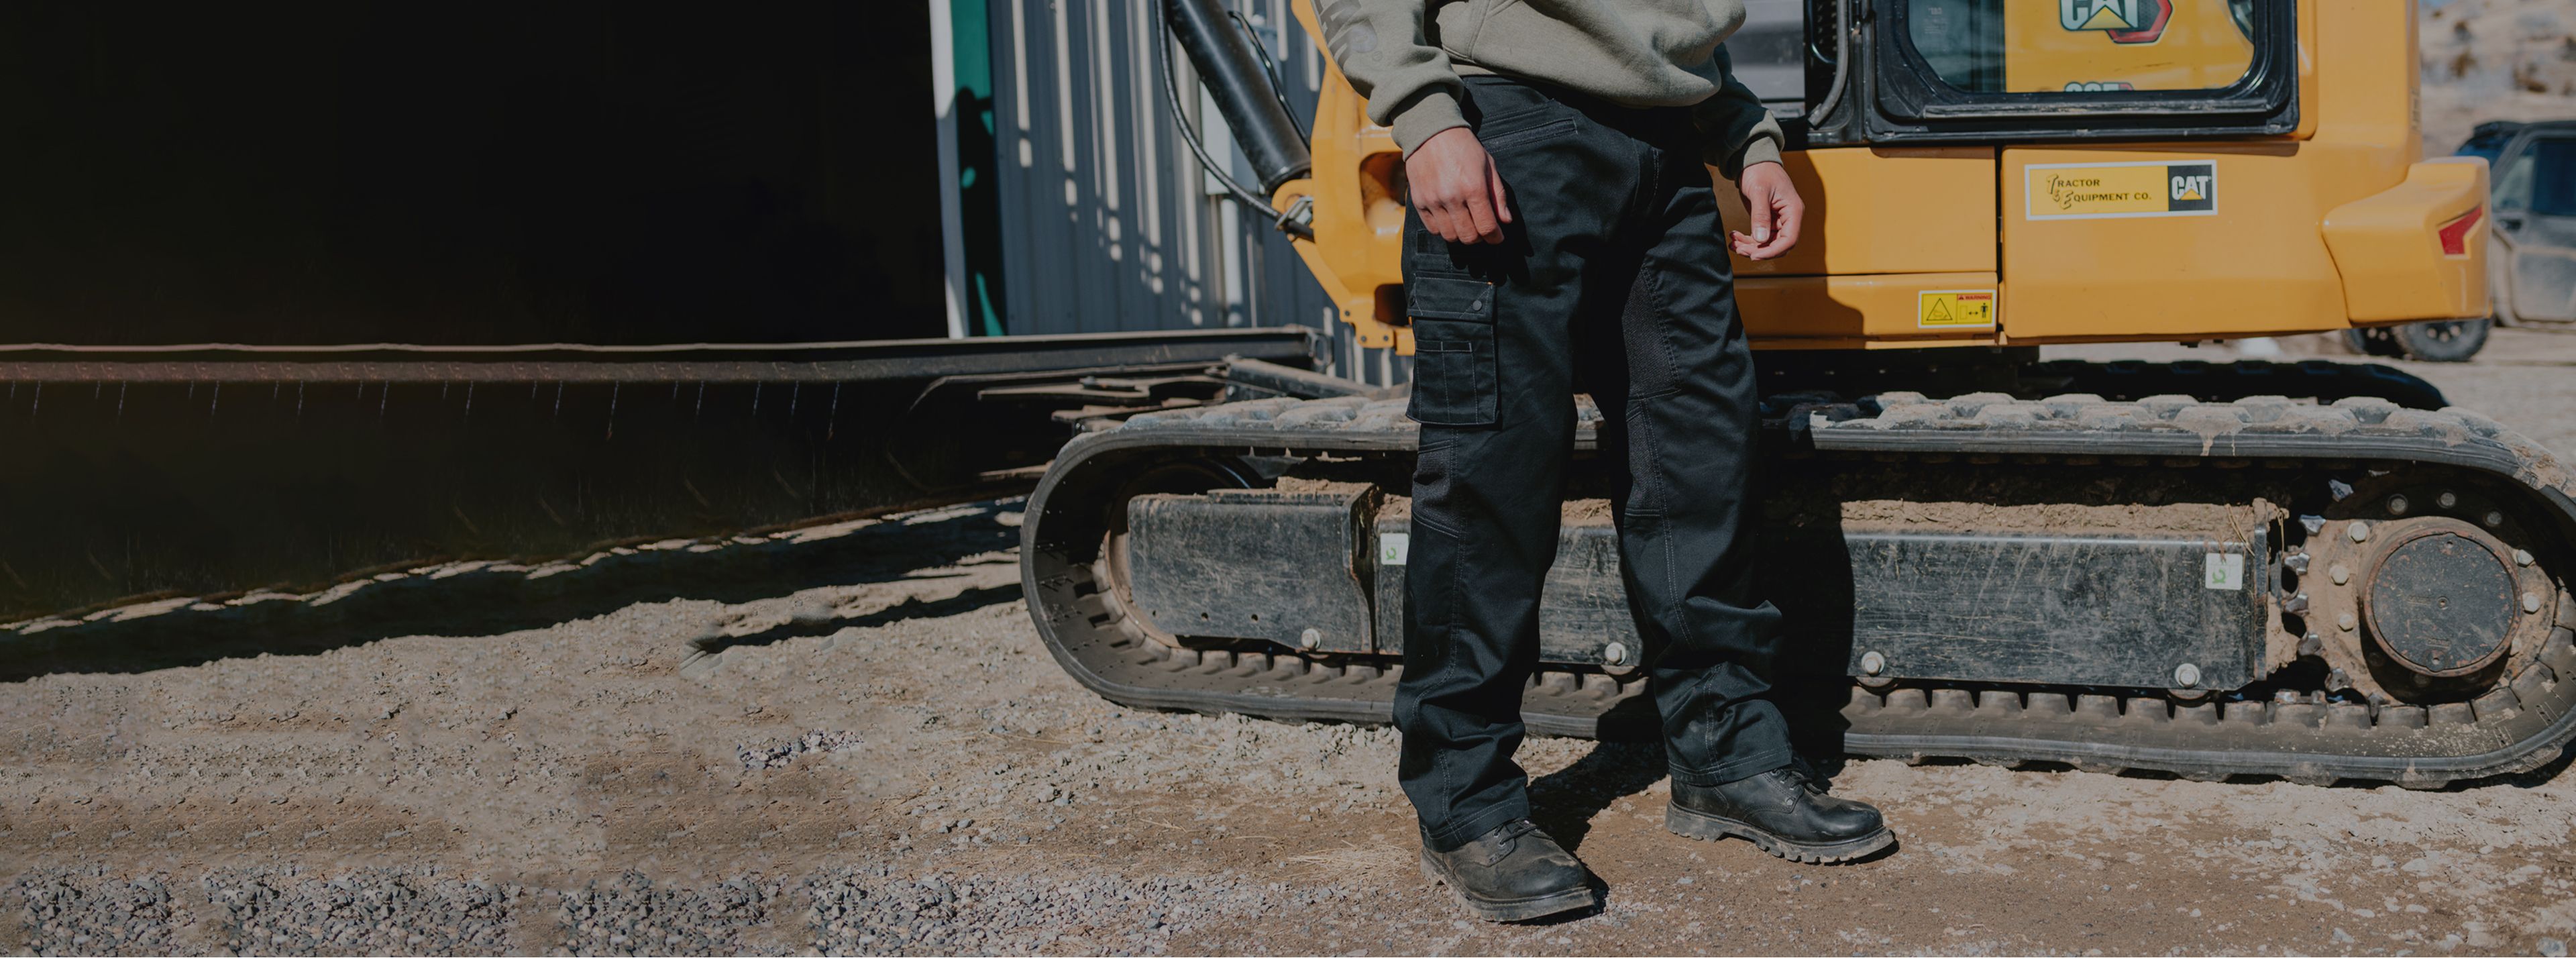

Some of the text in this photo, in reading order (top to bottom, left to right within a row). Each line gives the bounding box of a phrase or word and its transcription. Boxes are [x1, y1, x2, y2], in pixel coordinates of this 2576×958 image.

[2047, 173, 2100, 195] TRACTOR
[2171, 176, 2208, 200] CAT
[2060, 189, 2129, 210] EQUIPMENT
[2134, 192, 2152, 201] CO.
